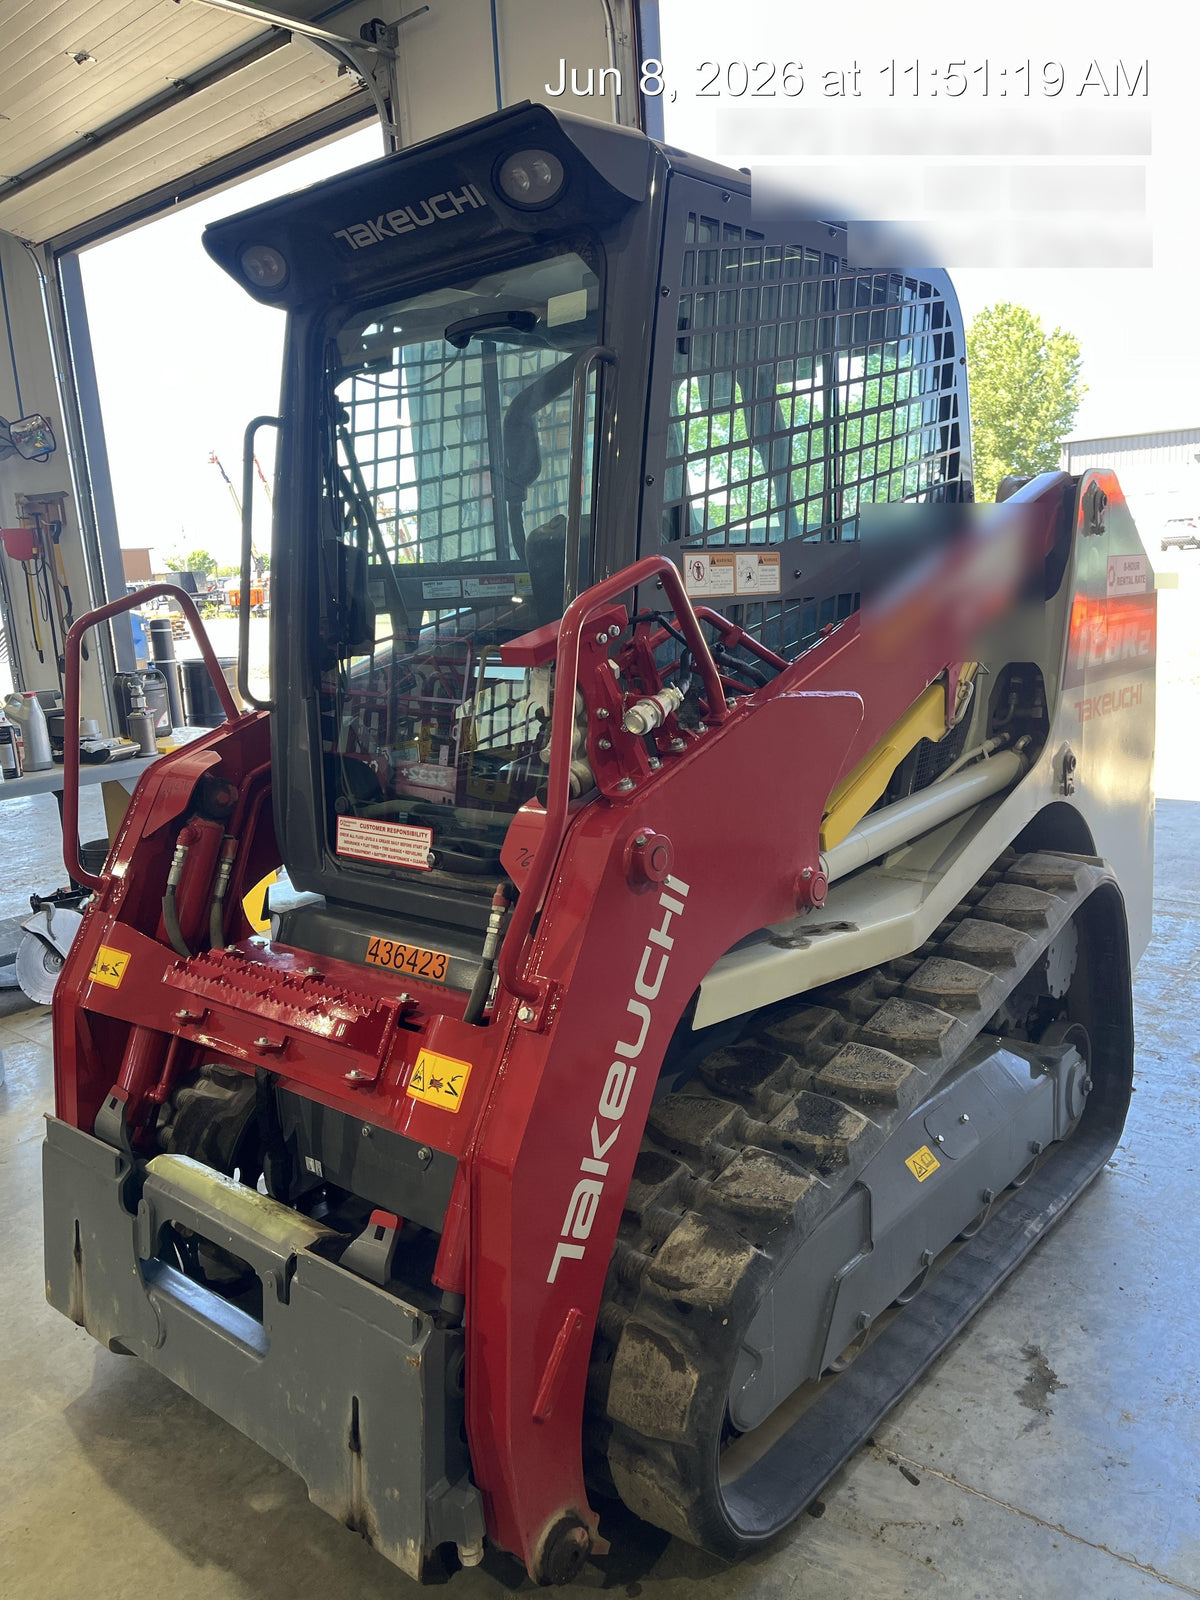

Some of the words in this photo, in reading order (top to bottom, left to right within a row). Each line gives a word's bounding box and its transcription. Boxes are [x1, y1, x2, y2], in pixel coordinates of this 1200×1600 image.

[1117, 575, 1134, 586] RENTAL
[1135, 574, 1146, 584] RATE
[360, 823, 386, 832] CUSTOMER
[387, 828, 428, 839] RESPONSIBILITY
[368, 939, 447, 979] 436423
